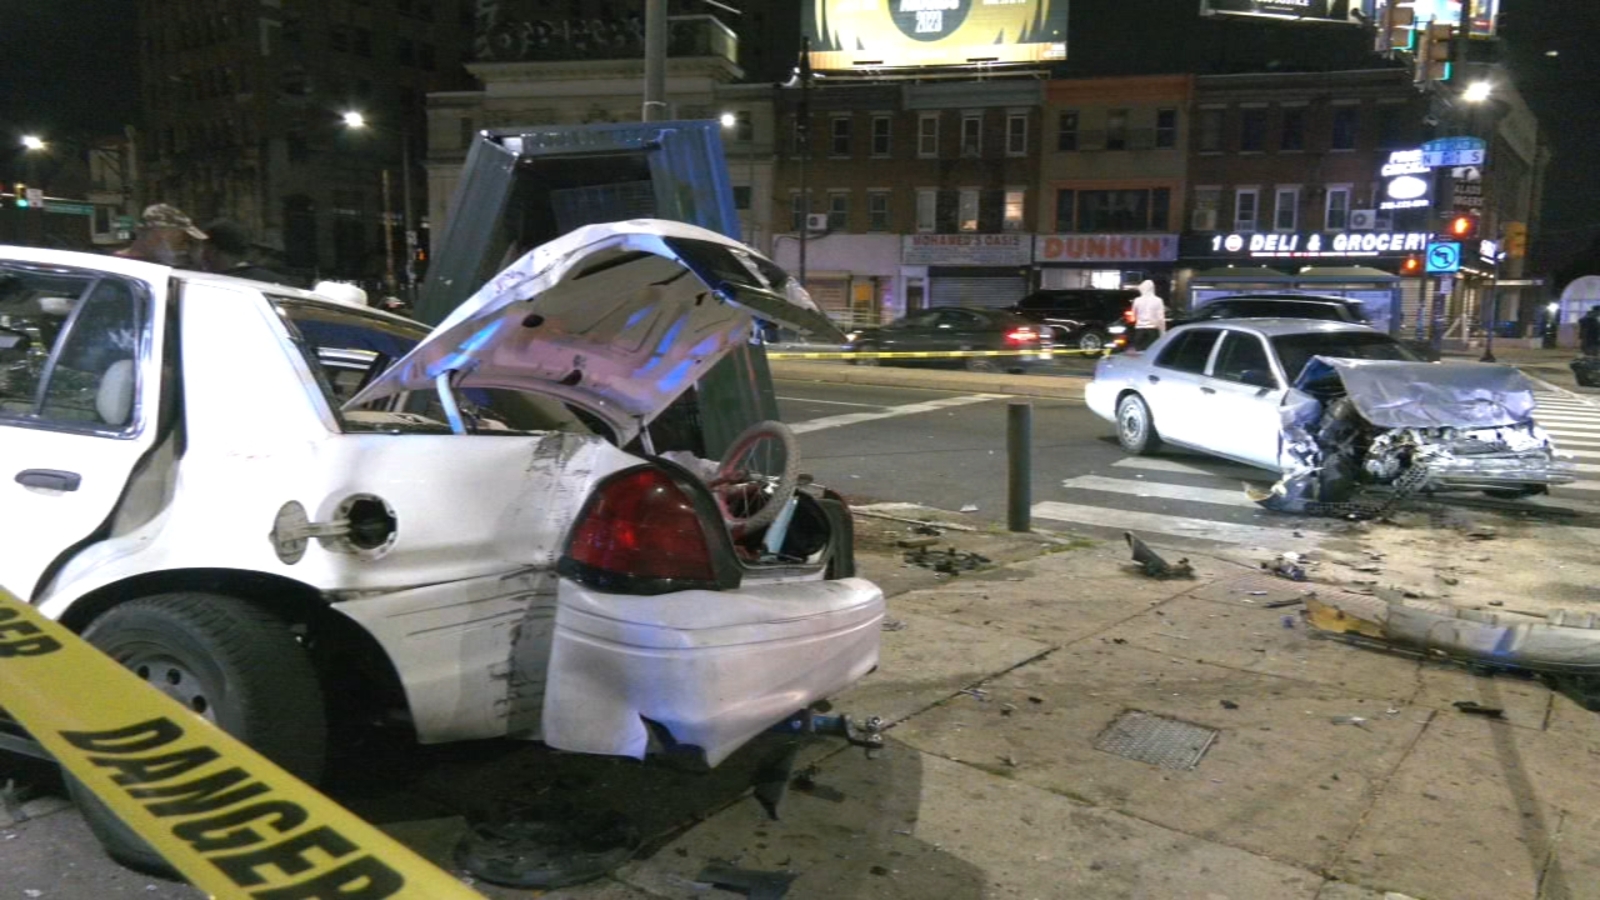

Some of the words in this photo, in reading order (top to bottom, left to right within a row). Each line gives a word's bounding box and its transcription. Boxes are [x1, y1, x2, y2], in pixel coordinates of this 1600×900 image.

[1043, 236, 1168, 259] DUNKIN'
[1250, 234, 1298, 251] DELI
[1307, 234, 1321, 251] &
